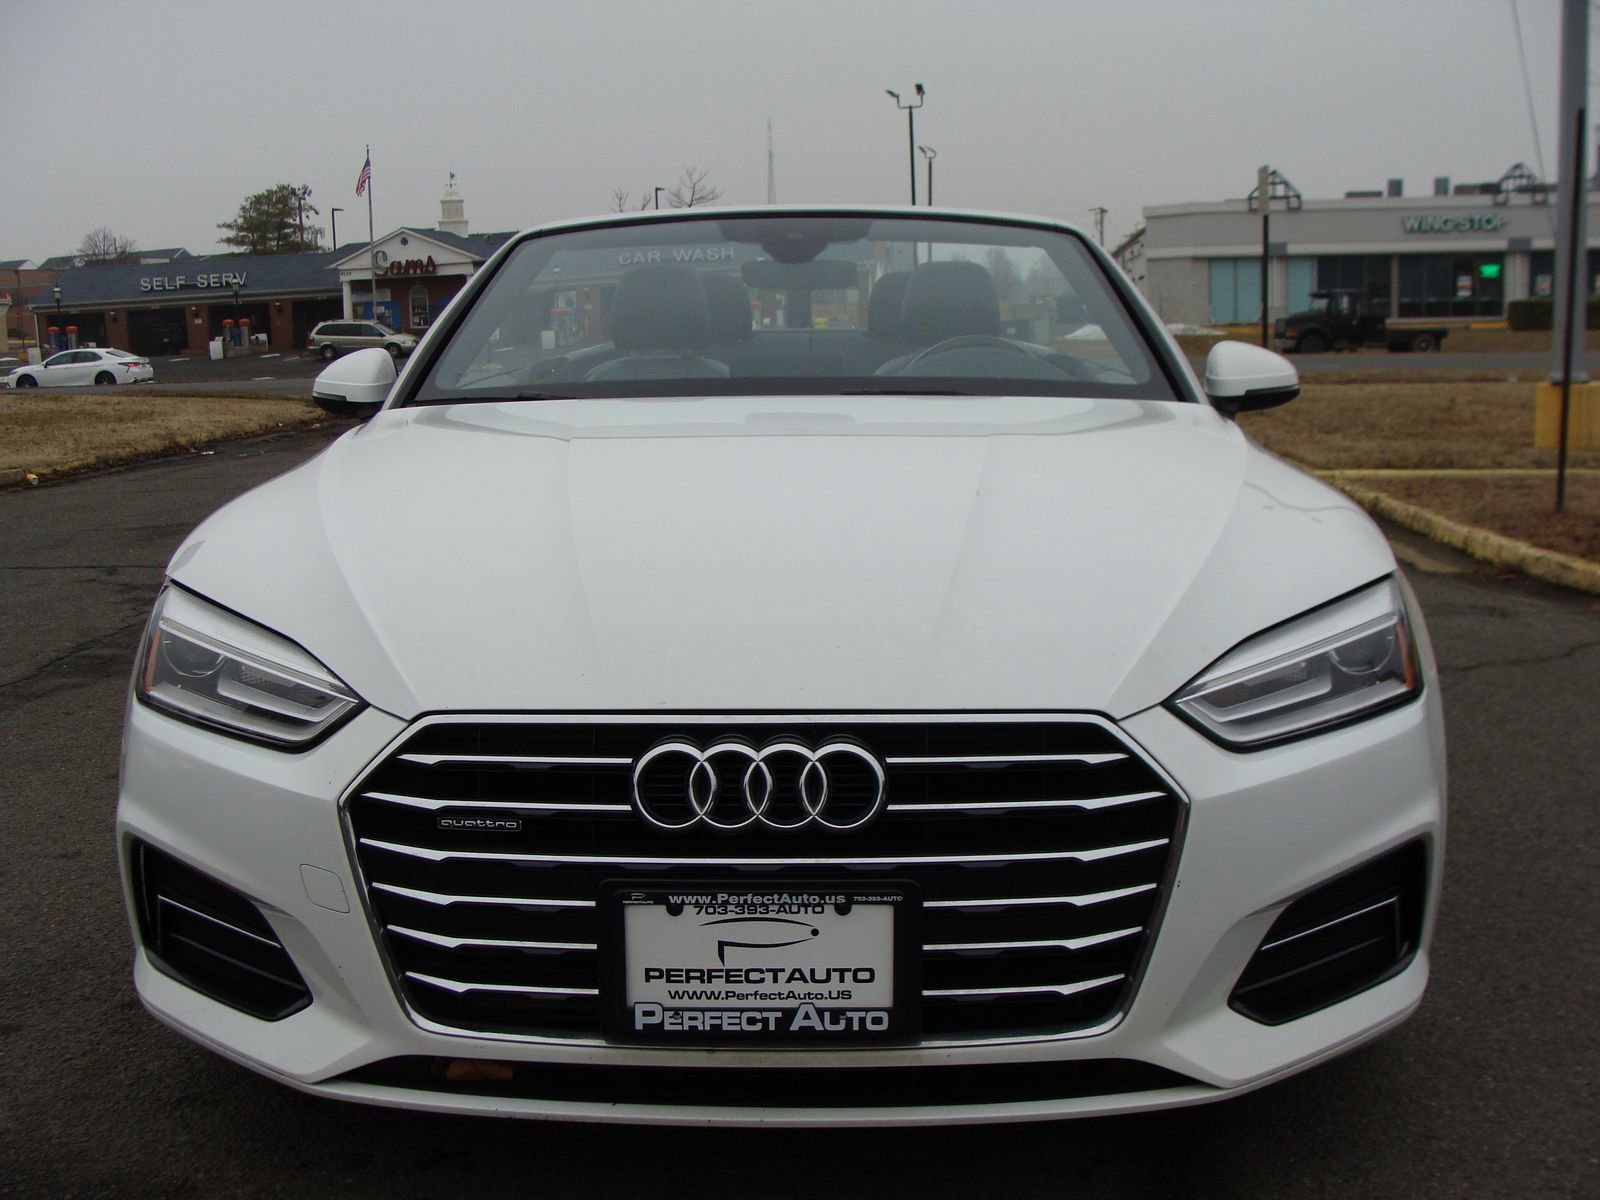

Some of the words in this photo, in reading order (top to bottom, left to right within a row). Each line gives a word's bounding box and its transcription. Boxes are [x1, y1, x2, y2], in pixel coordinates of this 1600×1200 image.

[619, 250, 661, 264] CAR
[672, 247, 735, 261] WASH
[140, 275, 186, 291] SELF
[197, 272, 247, 288] SERV
[441, 819, 517, 828] quattro
[668, 893, 846, 904] www.PerfectAuto.us
[693, 905, 825, 915] 703-393-AUTO
[644, 967, 875, 984] PERFECTAUTO
[668, 990, 852, 1001] WWW.PerfectAuto.US
